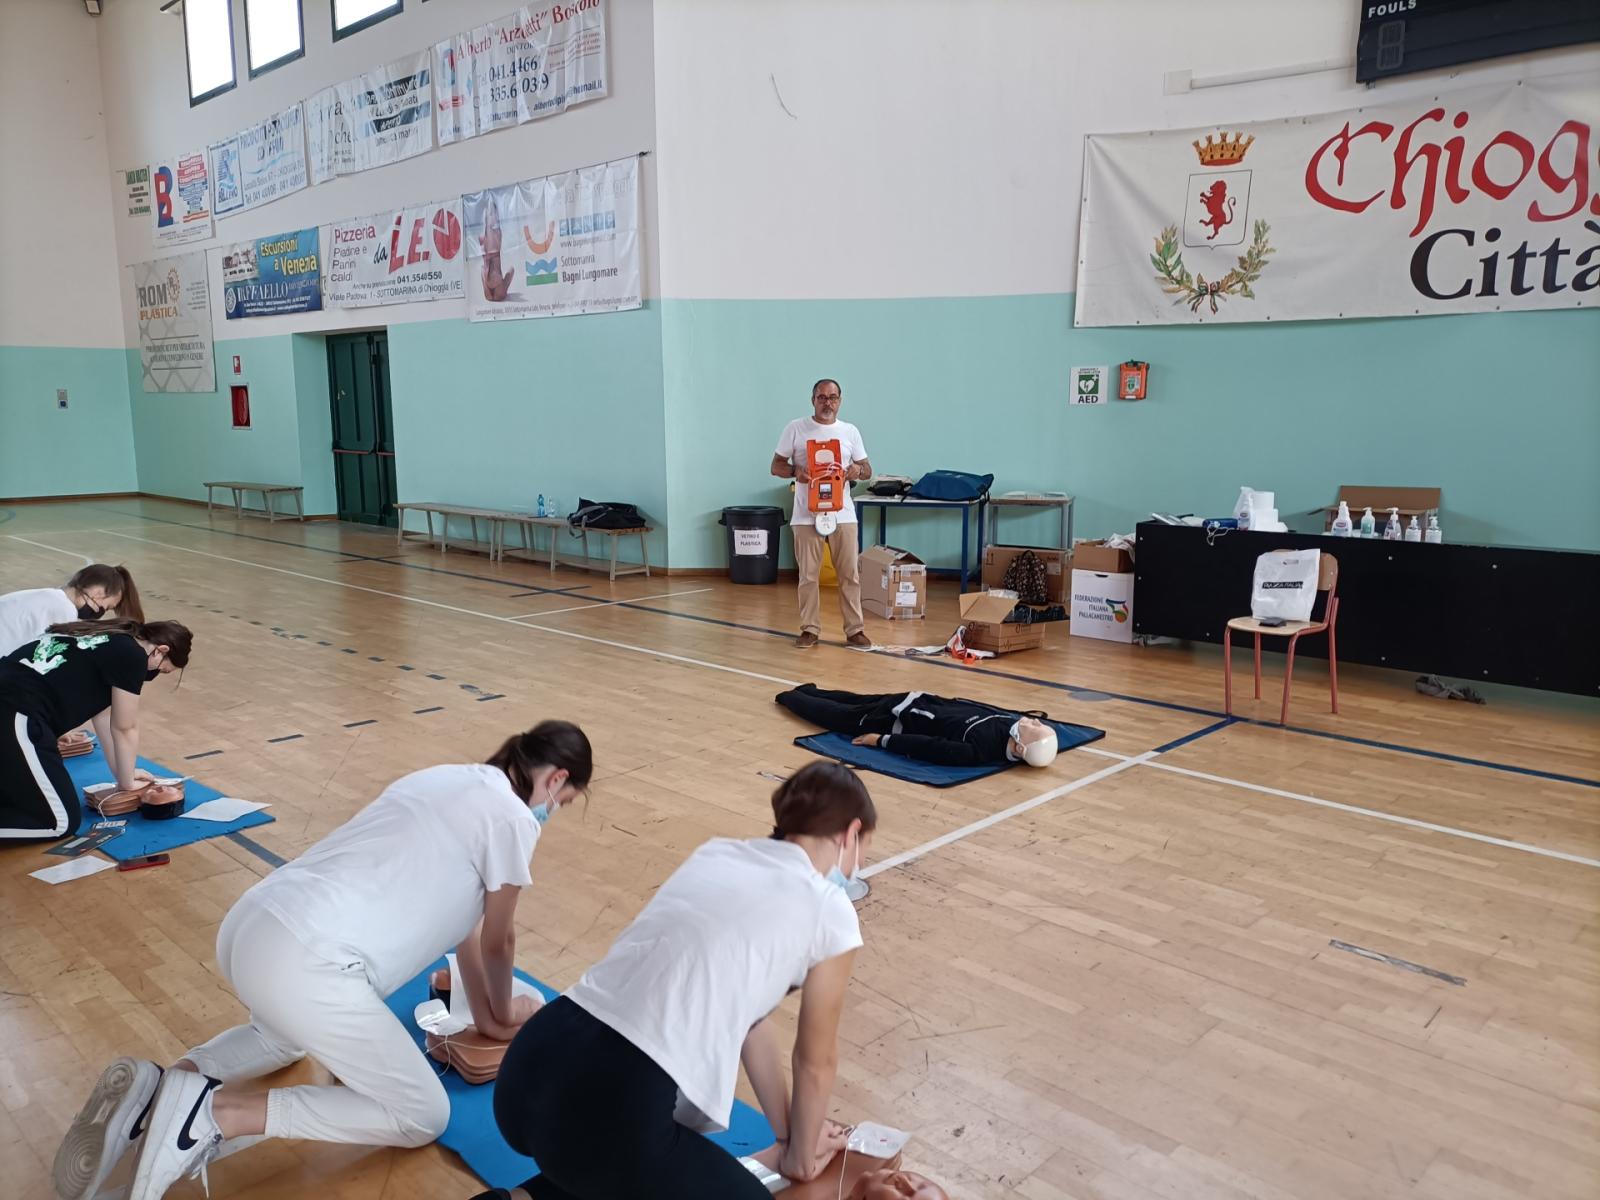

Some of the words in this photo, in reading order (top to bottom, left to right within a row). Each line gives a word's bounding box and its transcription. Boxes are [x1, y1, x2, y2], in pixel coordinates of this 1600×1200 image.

[1368, 0, 1416, 18] FOULS
[1304, 107, 1600, 238] Chiog
[334, 223, 376, 244] Pizzeria
[260, 234, 298, 257] Escursioni
[373, 242, 388, 265] da
[274, 258, 279, 271] a
[280, 251, 318, 276] Venezia
[330, 271, 353, 282] caldi
[562, 269, 581, 285] Bagni
[581, 266, 619, 282] Lungomare
[139, 306, 178, 321] PLASTICA
[1078, 395, 1099, 404] AED
[1075, 594, 1103, 603] FEDERAZIONE
[1078, 611, 1114, 622] PALLACANESTRO
[1089, 604, 1109, 612] ITALIANA
